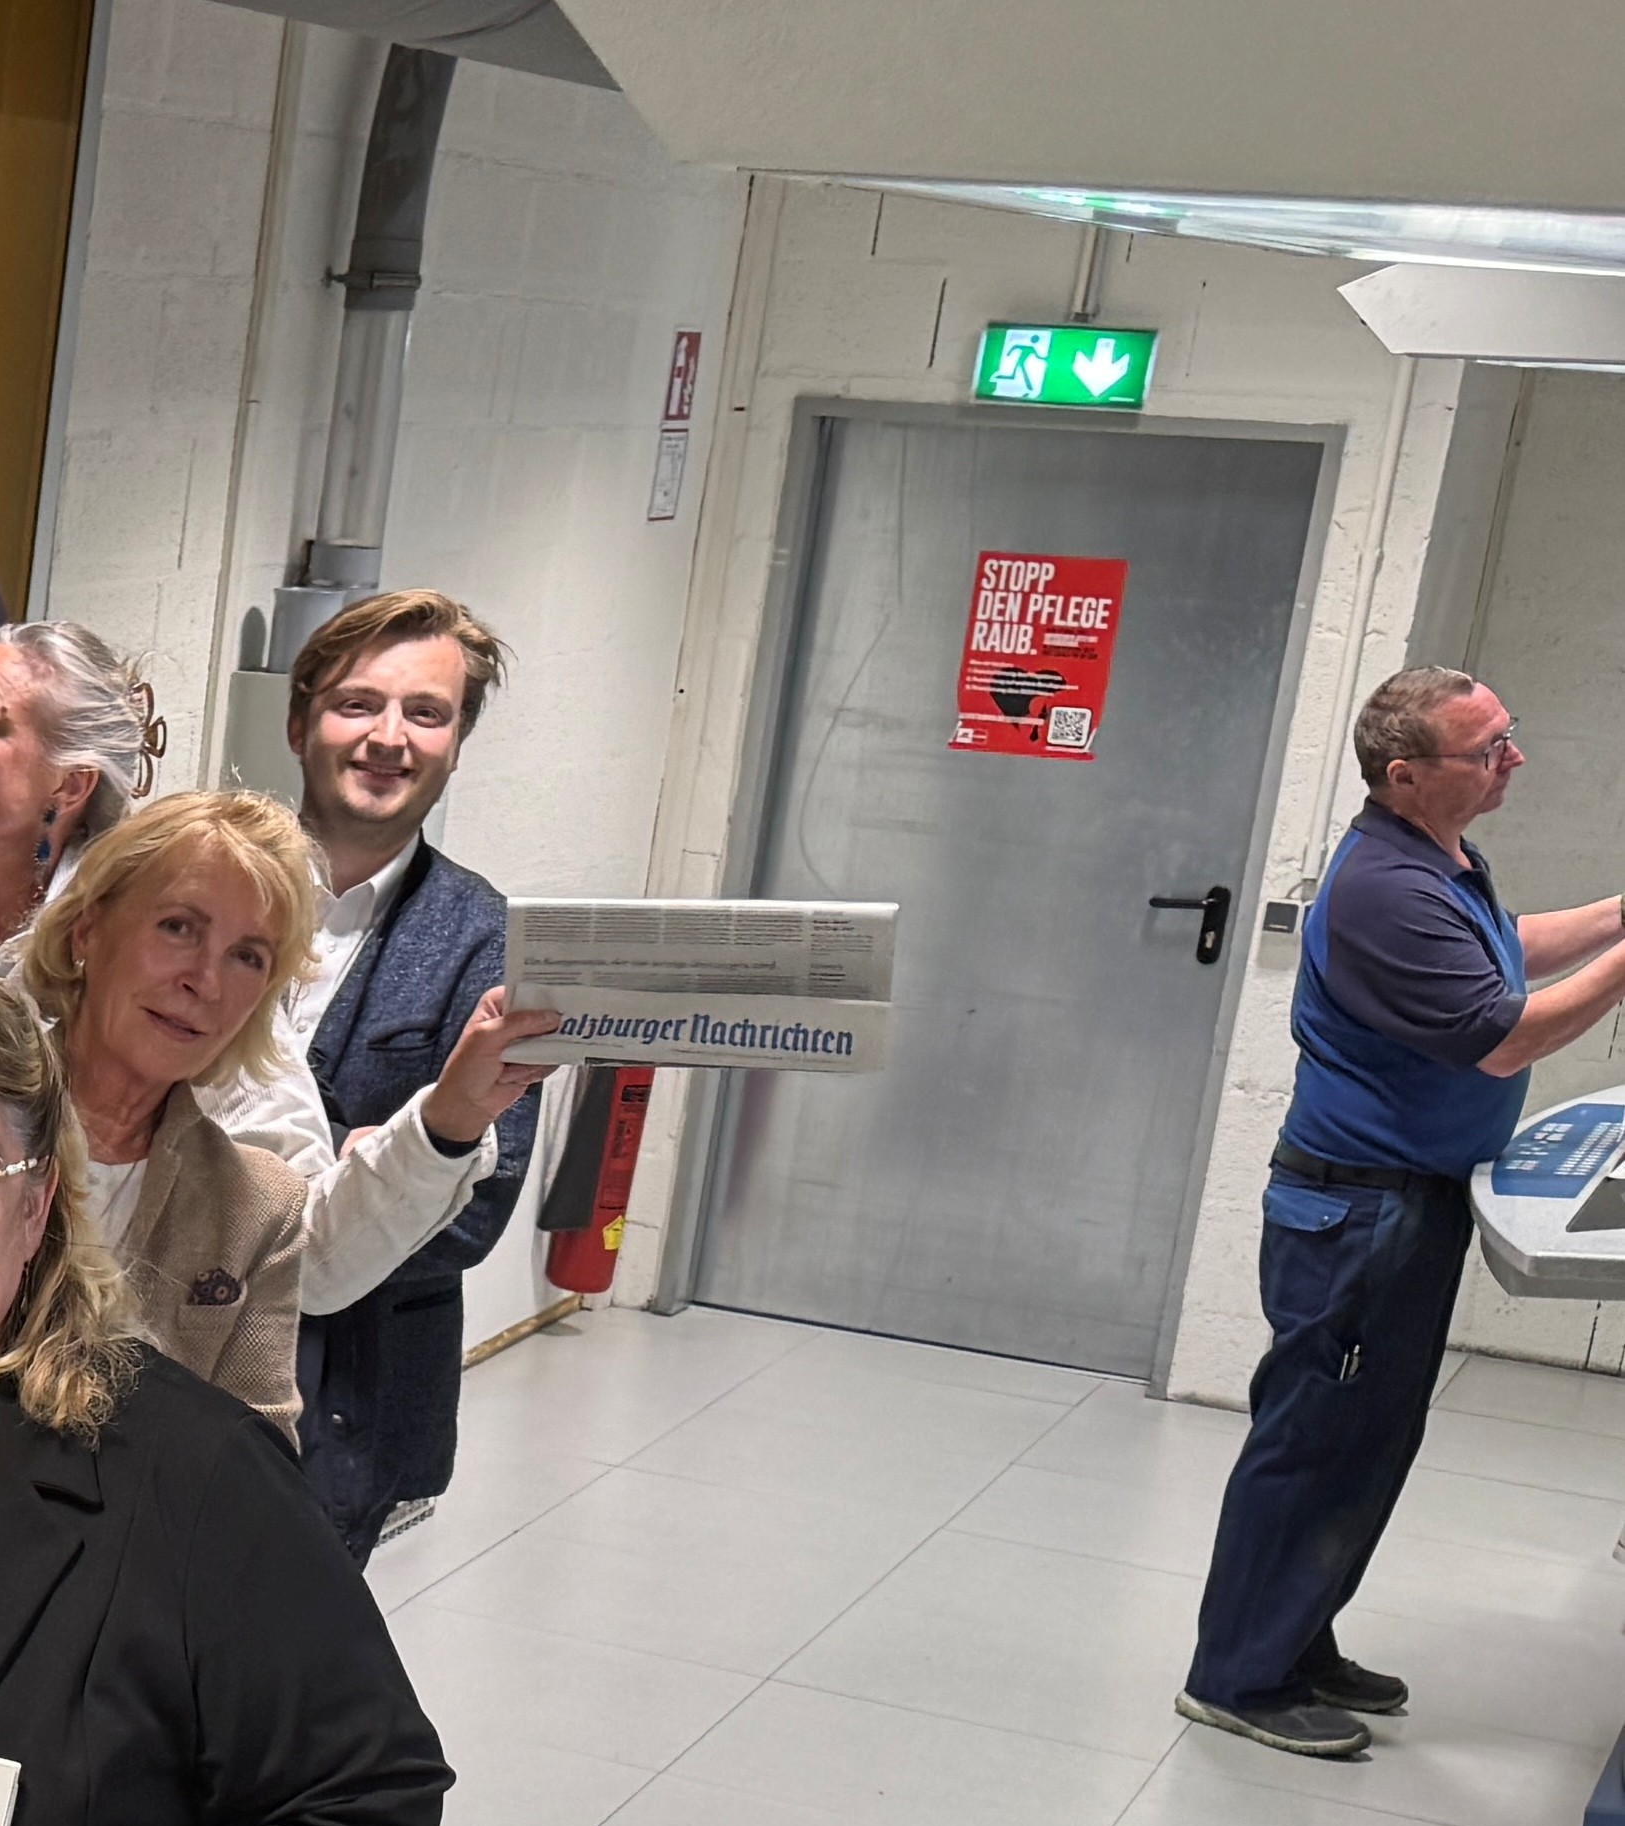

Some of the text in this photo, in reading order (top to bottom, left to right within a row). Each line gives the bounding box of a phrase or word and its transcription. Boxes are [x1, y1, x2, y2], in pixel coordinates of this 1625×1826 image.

[981, 558, 1056, 594] STOPP
[976, 591, 1113, 630] DEN PFLEGE
[970, 621, 1038, 656] RAUB.
[558, 1012, 687, 1046] alzburger
[689, 1012, 855, 1057] Nachrichten
